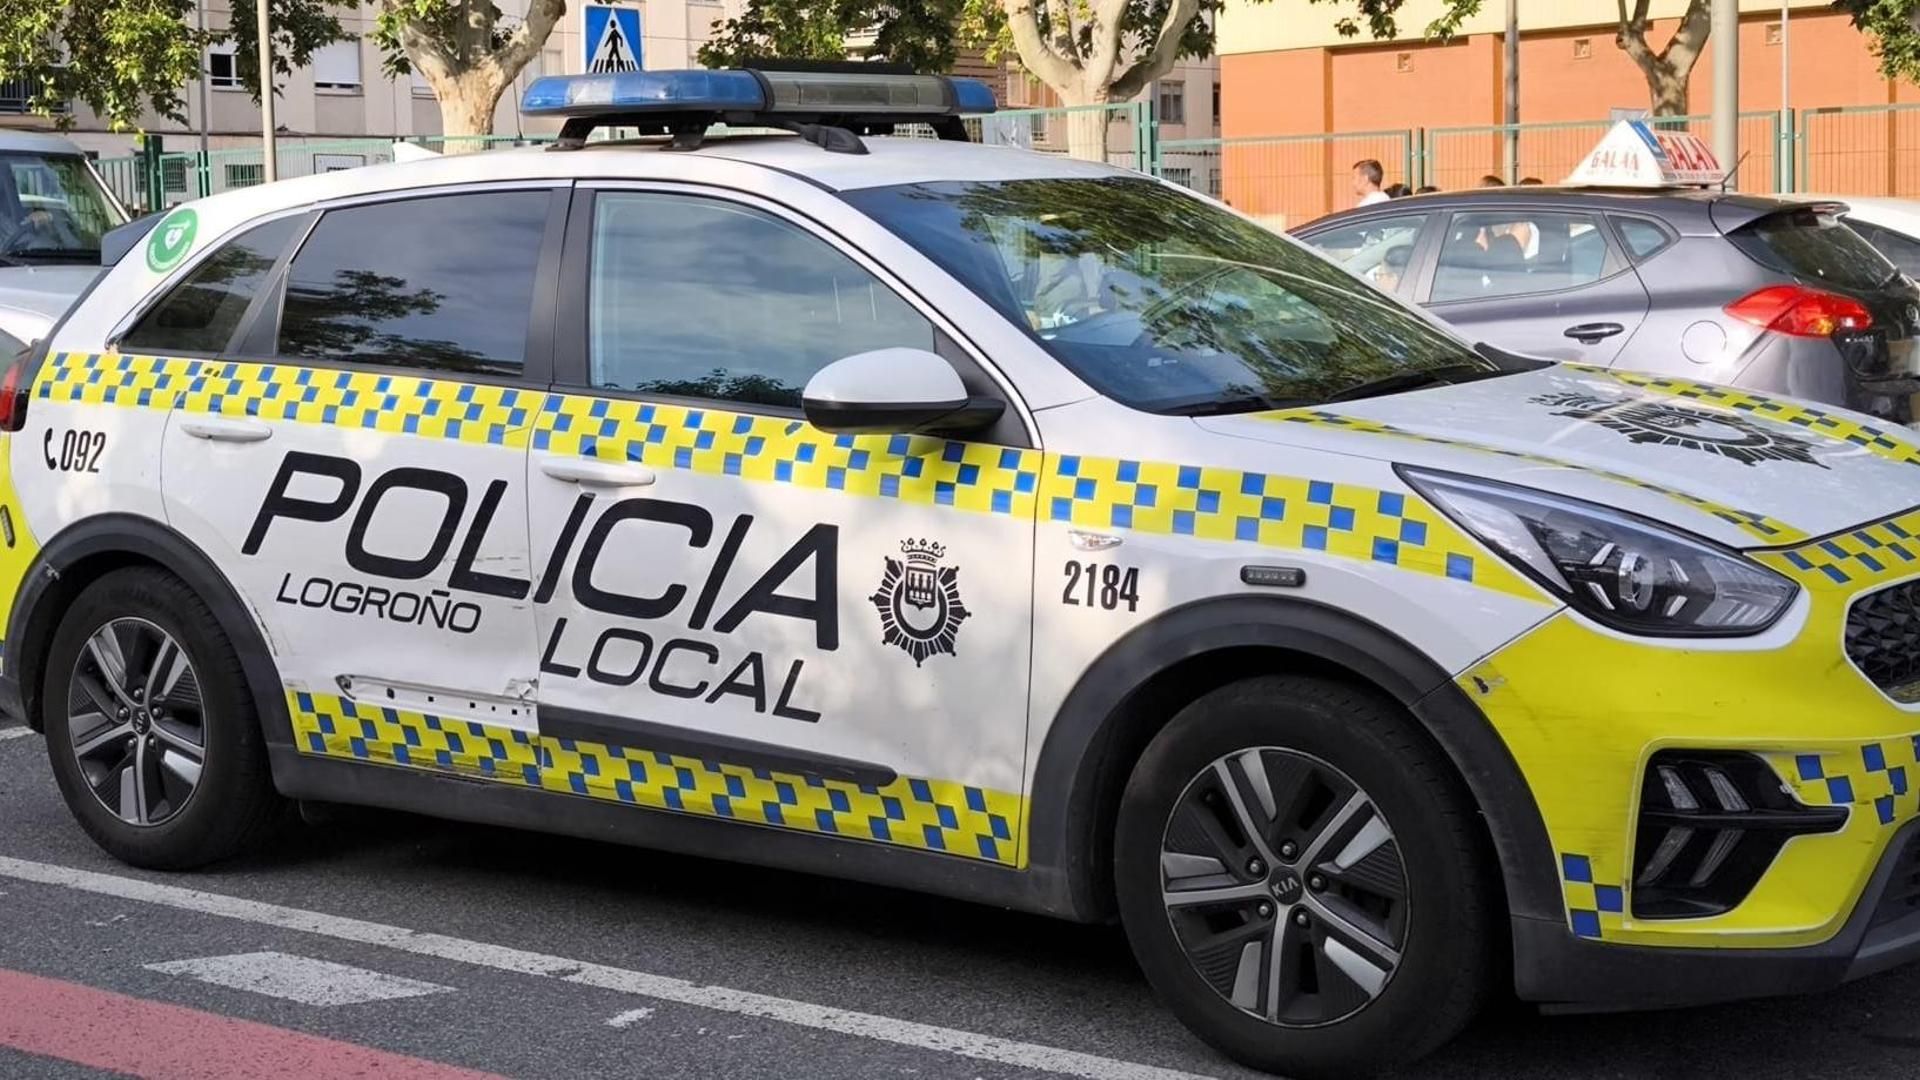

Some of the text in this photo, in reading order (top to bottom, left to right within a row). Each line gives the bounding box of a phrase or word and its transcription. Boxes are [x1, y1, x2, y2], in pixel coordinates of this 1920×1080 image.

[60, 429, 106, 473] 092
[241, 451, 838, 651] POLICIA
[276, 572, 482, 634] LOGROÑO
[1062, 560, 1139, 612] 2184
[540, 617, 821, 724] LOCAL
[1271, 877, 1299, 897] KIA
